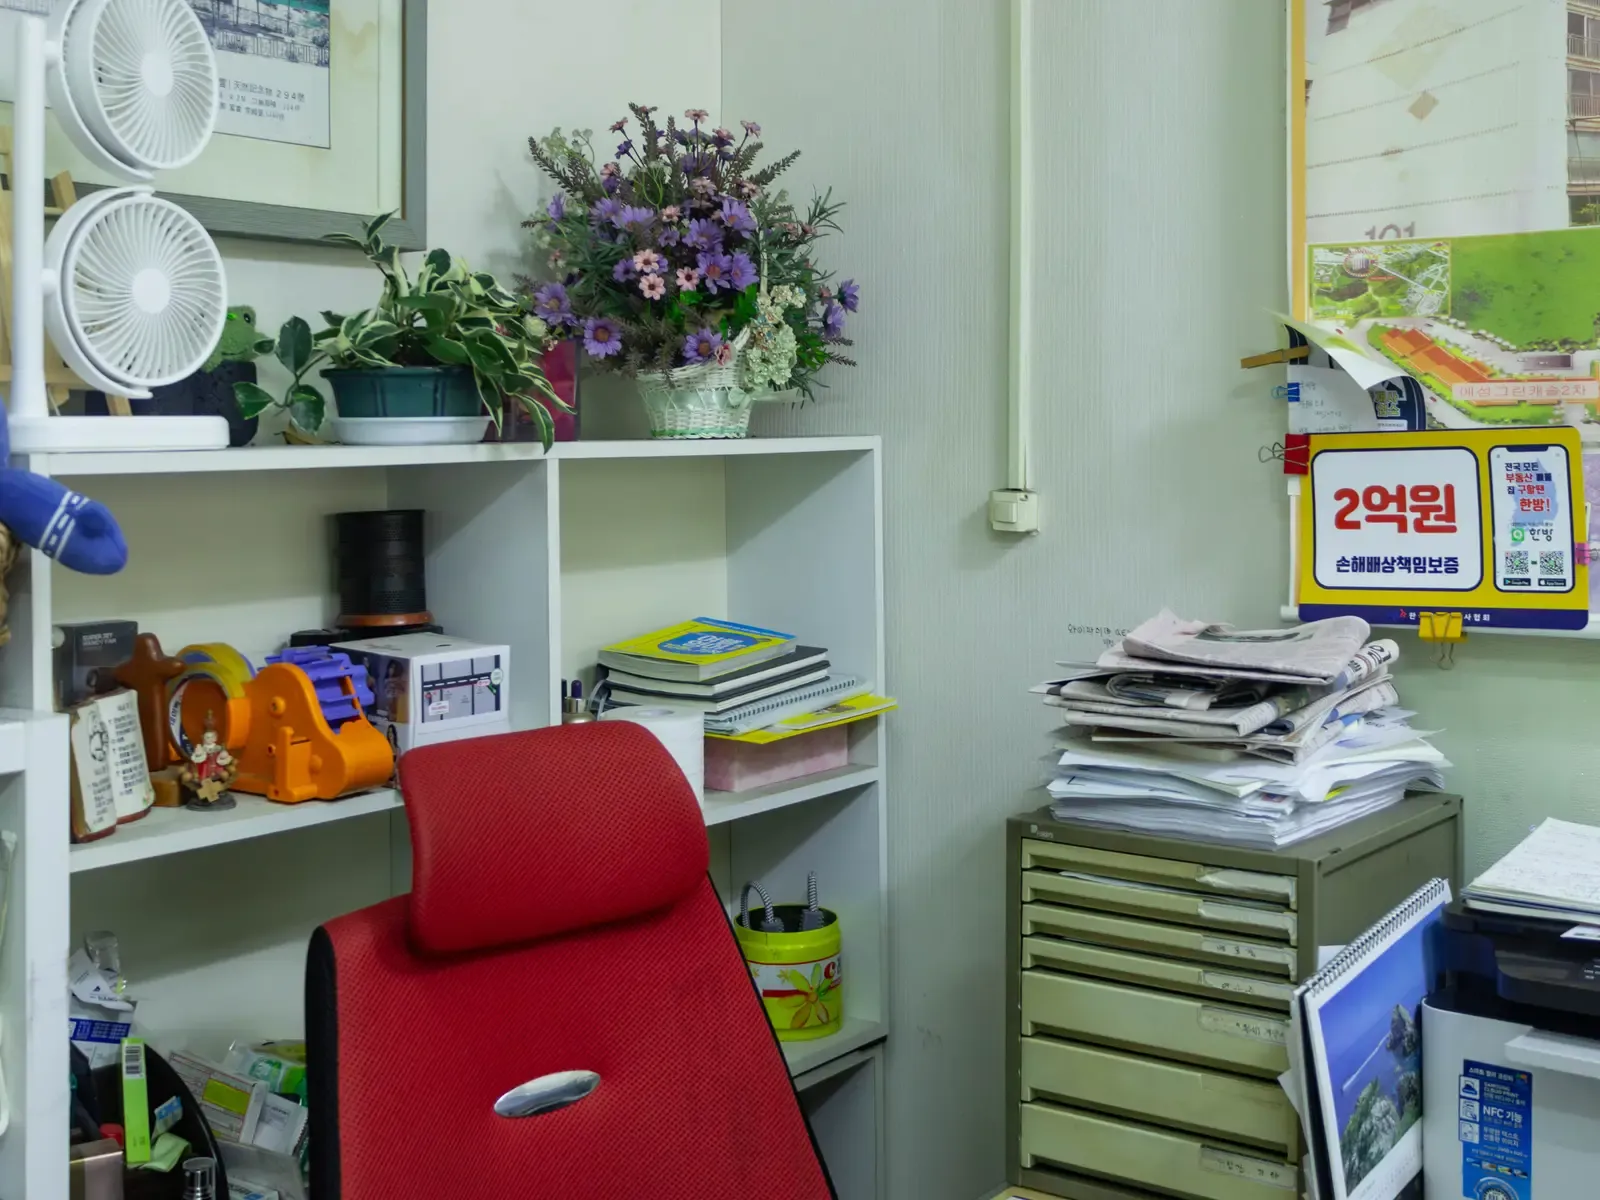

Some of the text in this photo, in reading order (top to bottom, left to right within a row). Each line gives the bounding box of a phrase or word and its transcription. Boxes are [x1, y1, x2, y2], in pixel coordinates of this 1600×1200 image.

[1504, 462, 1539, 472] 전국 모든
[1506, 473, 1533, 483] 부동산
[1334, 484, 1458, 534] 2억원
[1519, 498, 1550, 512] 한방!
[1529, 528, 1554, 542] 한방
[1336, 555, 1460, 574] 손해배상책임보증
[1483, 1105, 1504, 1119] NFC
[1505, 1111, 1523, 1123] 기능
